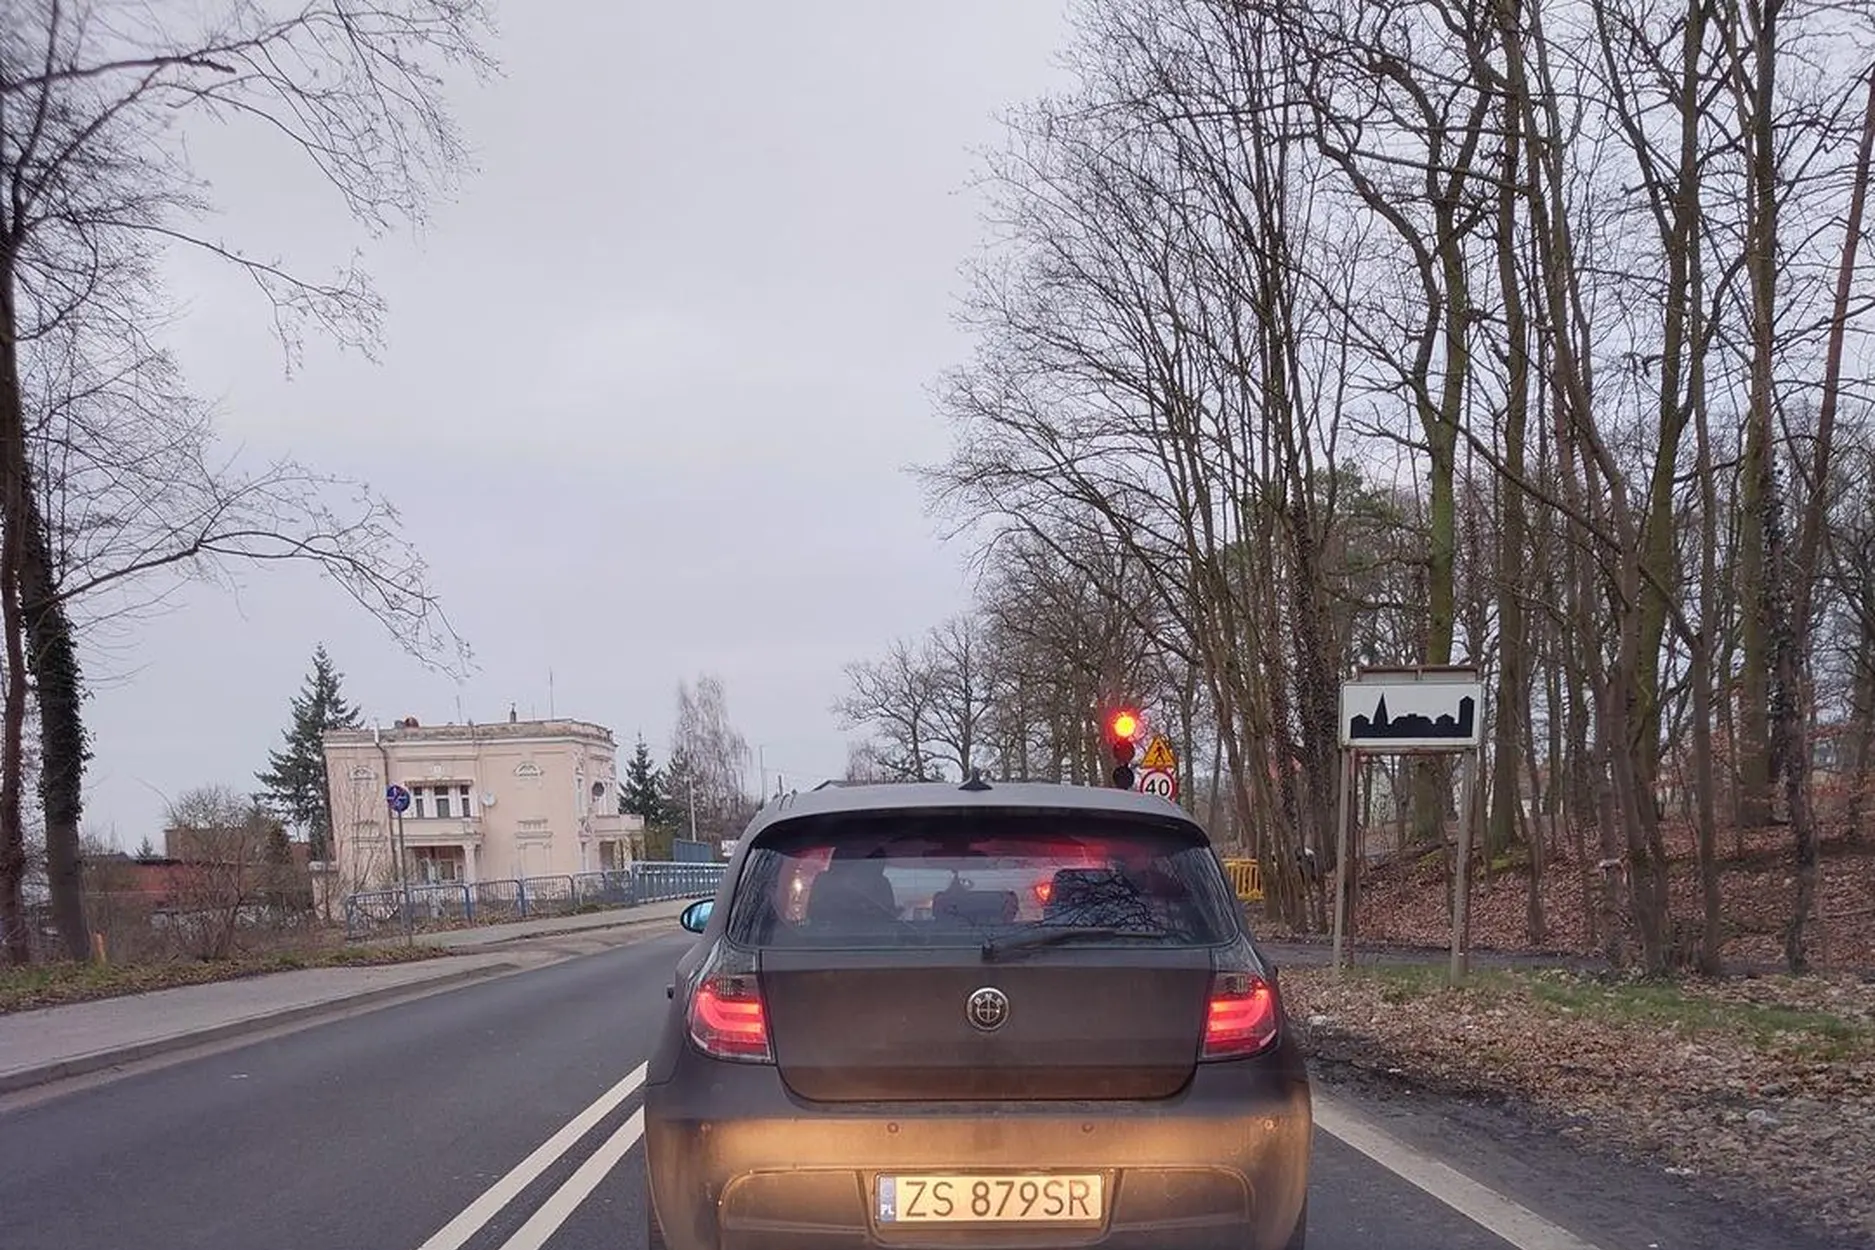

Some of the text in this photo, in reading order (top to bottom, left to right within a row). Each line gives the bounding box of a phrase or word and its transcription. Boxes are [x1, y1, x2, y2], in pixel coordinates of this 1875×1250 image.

[1145, 779, 1170, 797] 40
[905, 1180, 1090, 1217] ZS 879SR
[880, 1203, 895, 1215] PL
